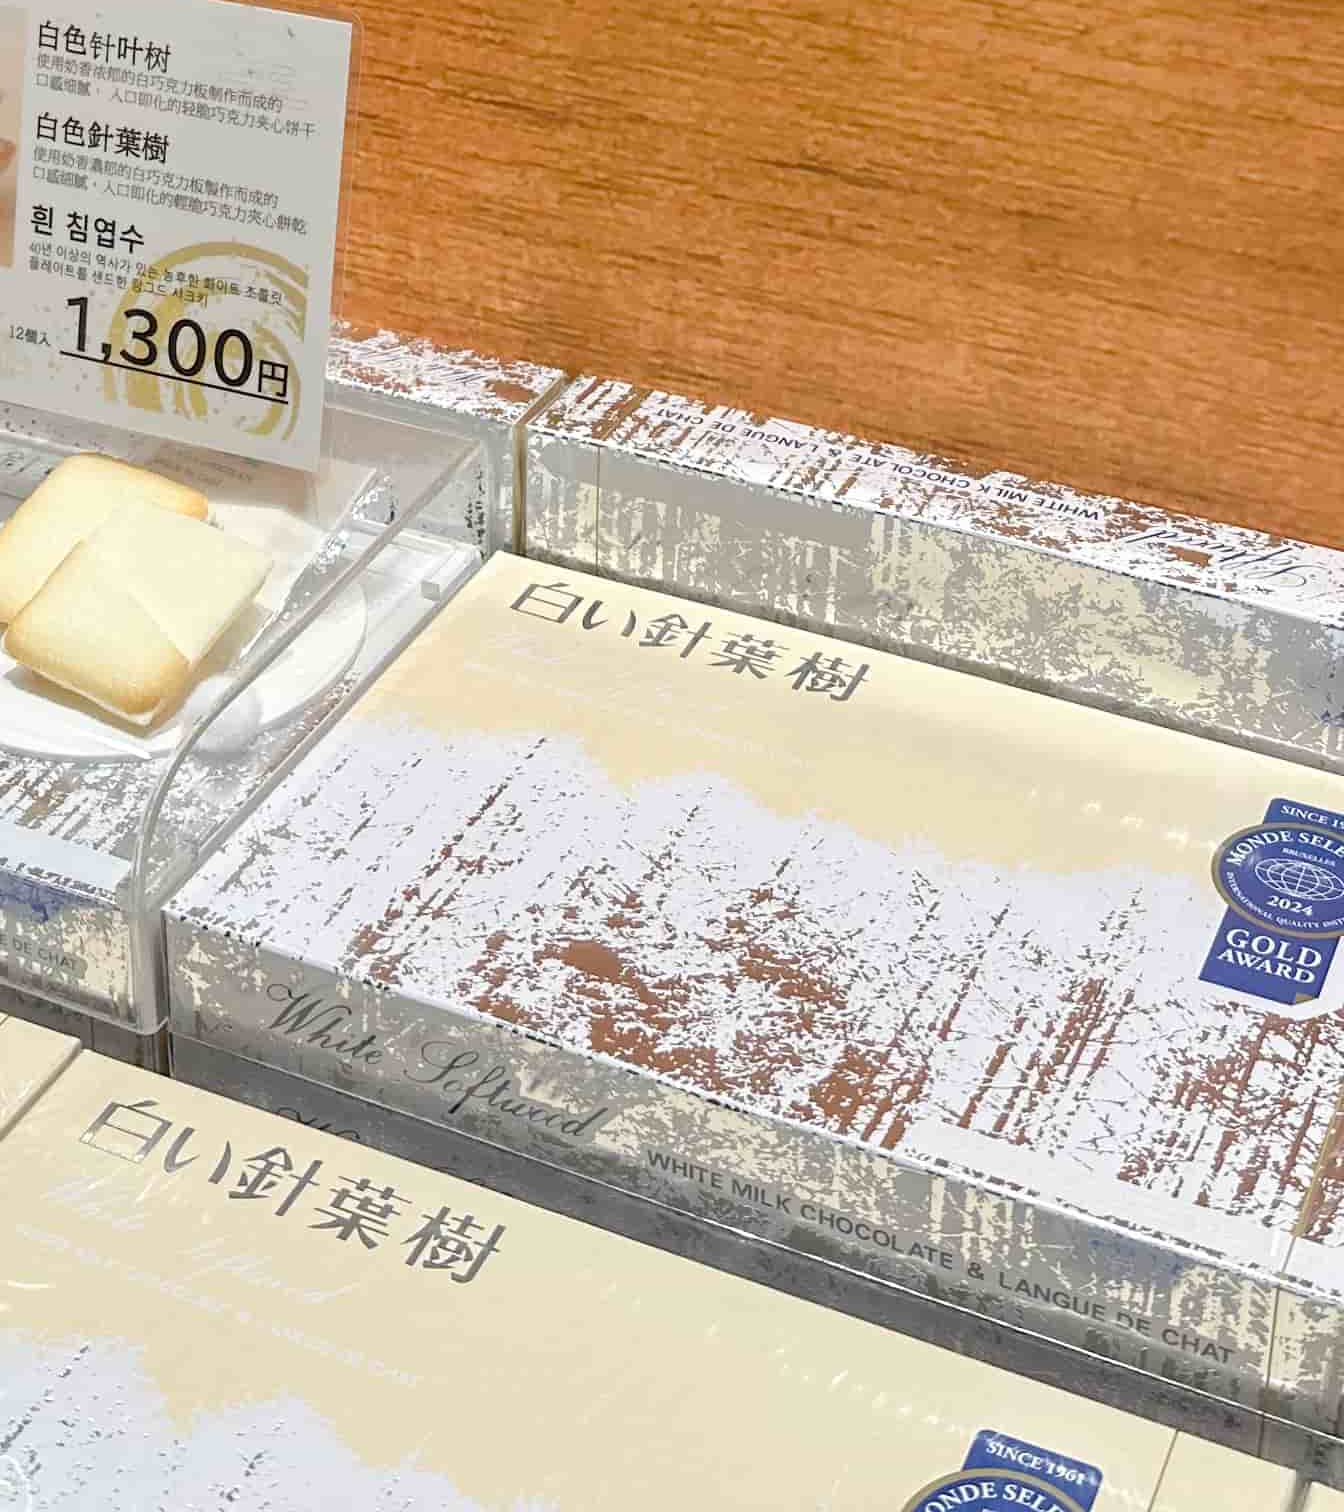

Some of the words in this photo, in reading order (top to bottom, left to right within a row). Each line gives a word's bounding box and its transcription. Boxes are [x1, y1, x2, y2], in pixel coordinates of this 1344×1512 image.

[37, 19, 172, 74] 白色针叶树
[36, 111, 170, 165] 白色針葉樹
[30, 204, 55, 238] 흰
[66, 211, 146, 255] 침엽수
[56, 243, 93, 266] 이상의
[97, 250, 132, 274] 역사가
[8, 324, 52, 348] 12個入
[65, 294, 291, 399] 1,300円
[655, 408, 705, 427] CHAT
[709, 421, 736, 434] DE
[741, 426, 819, 454] LANGUE
[849, 453, 970, 489] CHOCOLATE
[977, 483, 1030, 505] MILK
[1044, 499, 1100, 521] WHITE
[508, 579, 872, 703] 白い針葉樹
[1280, 804, 1328, 825] SINCE
[1226, 829, 1296, 868] MONDE
[1266, 894, 1314, 917] 2024
[13, 936, 35, 955] DE
[1225, 928, 1323, 969] GOLD
[1217, 948, 1316, 984] AWARD
[266, 981, 386, 1070] White
[417, 1037, 616, 1141] Softwood
[647, 1149, 724, 1194] WHITE
[730, 1172, 793, 1217] MILK
[799, 1201, 956, 1273] CHOCOLATE
[997, 1272, 1108, 1326] LANGUE
[1116, 1309, 1153, 1335] DE
[1161, 1325, 1235, 1366] CHAT
[77, 1099, 507, 1285] 白い針葉樹
[985, 1437, 1043, 1472] SINCE
